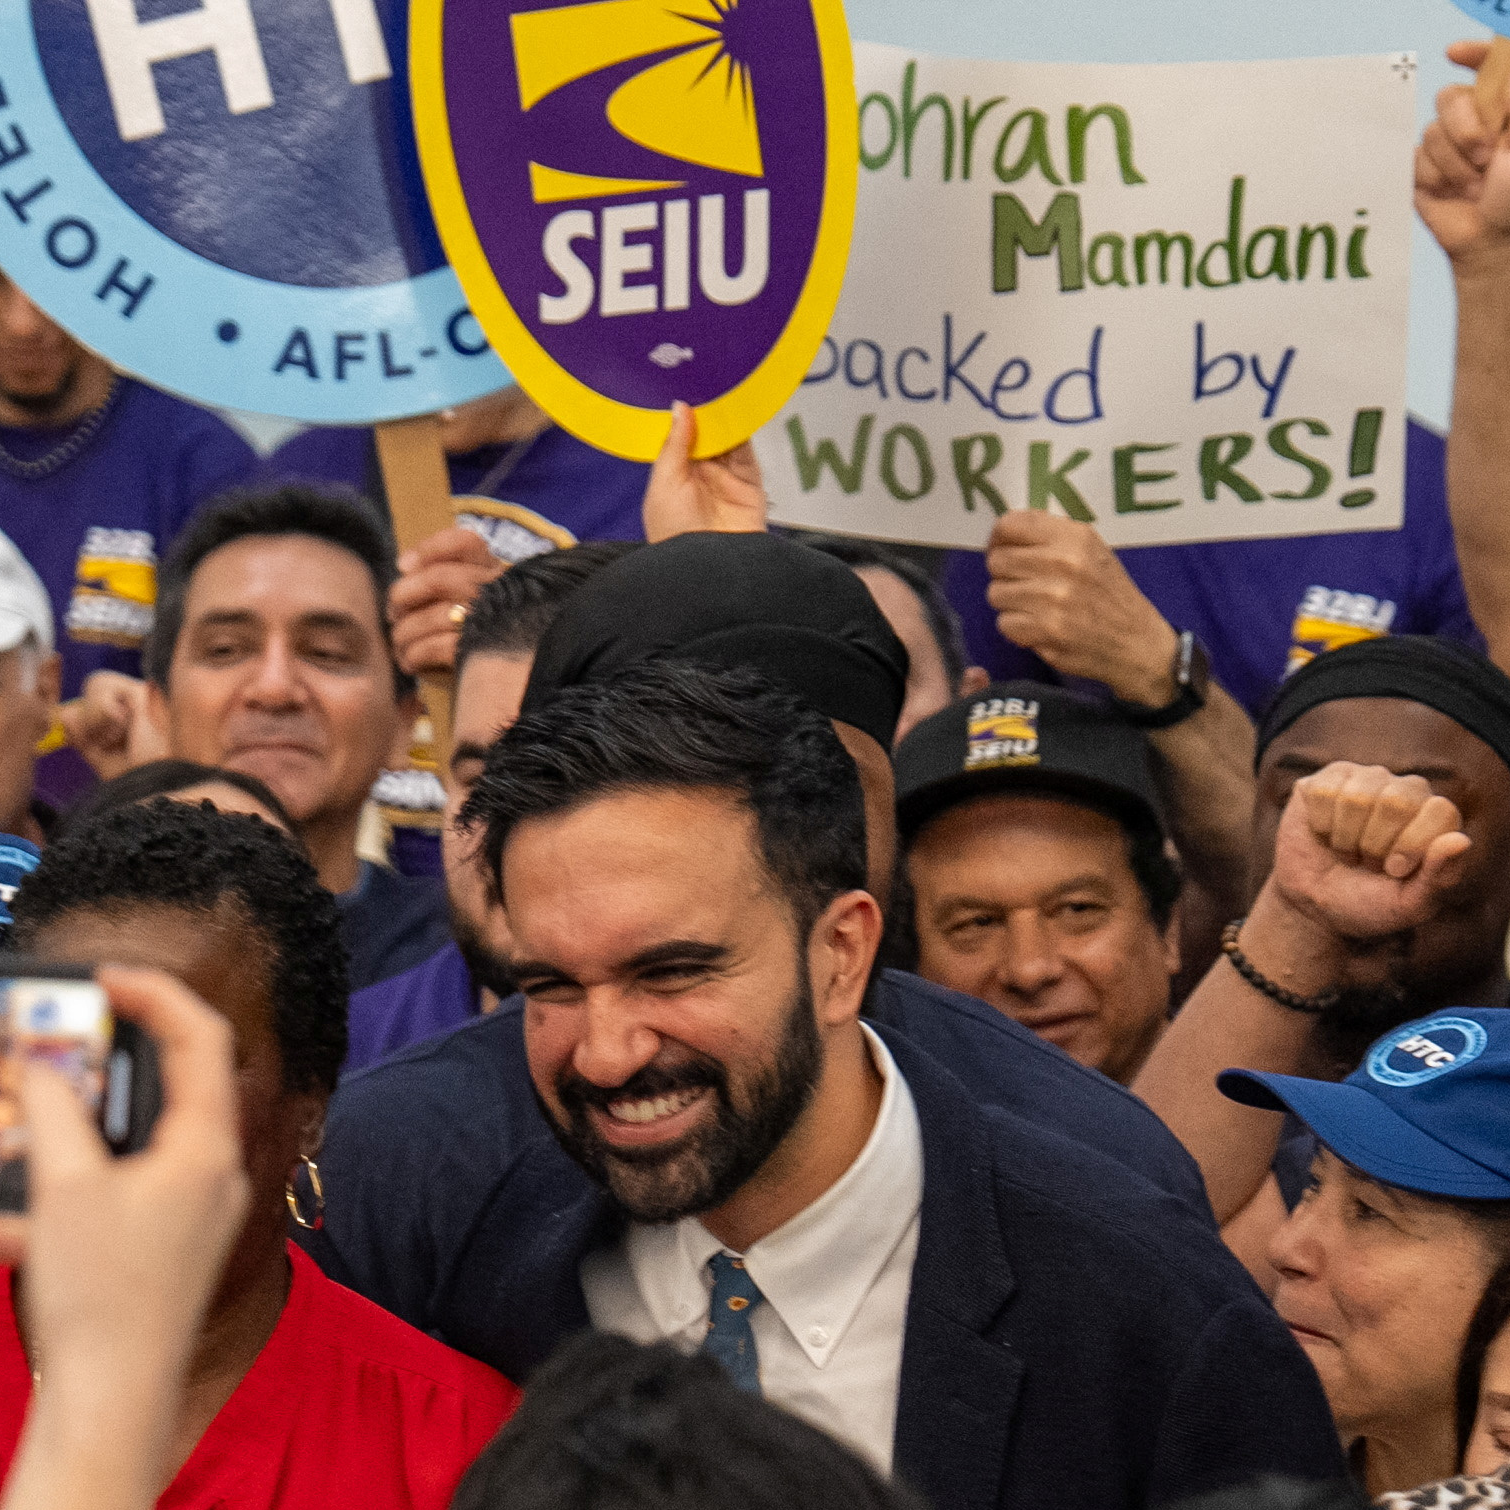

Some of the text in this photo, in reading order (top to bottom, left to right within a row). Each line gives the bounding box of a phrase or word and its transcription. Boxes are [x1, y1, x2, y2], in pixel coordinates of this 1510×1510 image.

[857, 60, 1147, 187] ohran
[539, 188, 771, 325] SEIU
[992, 175, 1370, 293] Mamdani
[271, 307, 490, 381] AFL-C
[1193, 322, 1296, 419] by
[785, 407, 1385, 522] WORKERS!
[1395, 1034, 1456, 1069] HTC
